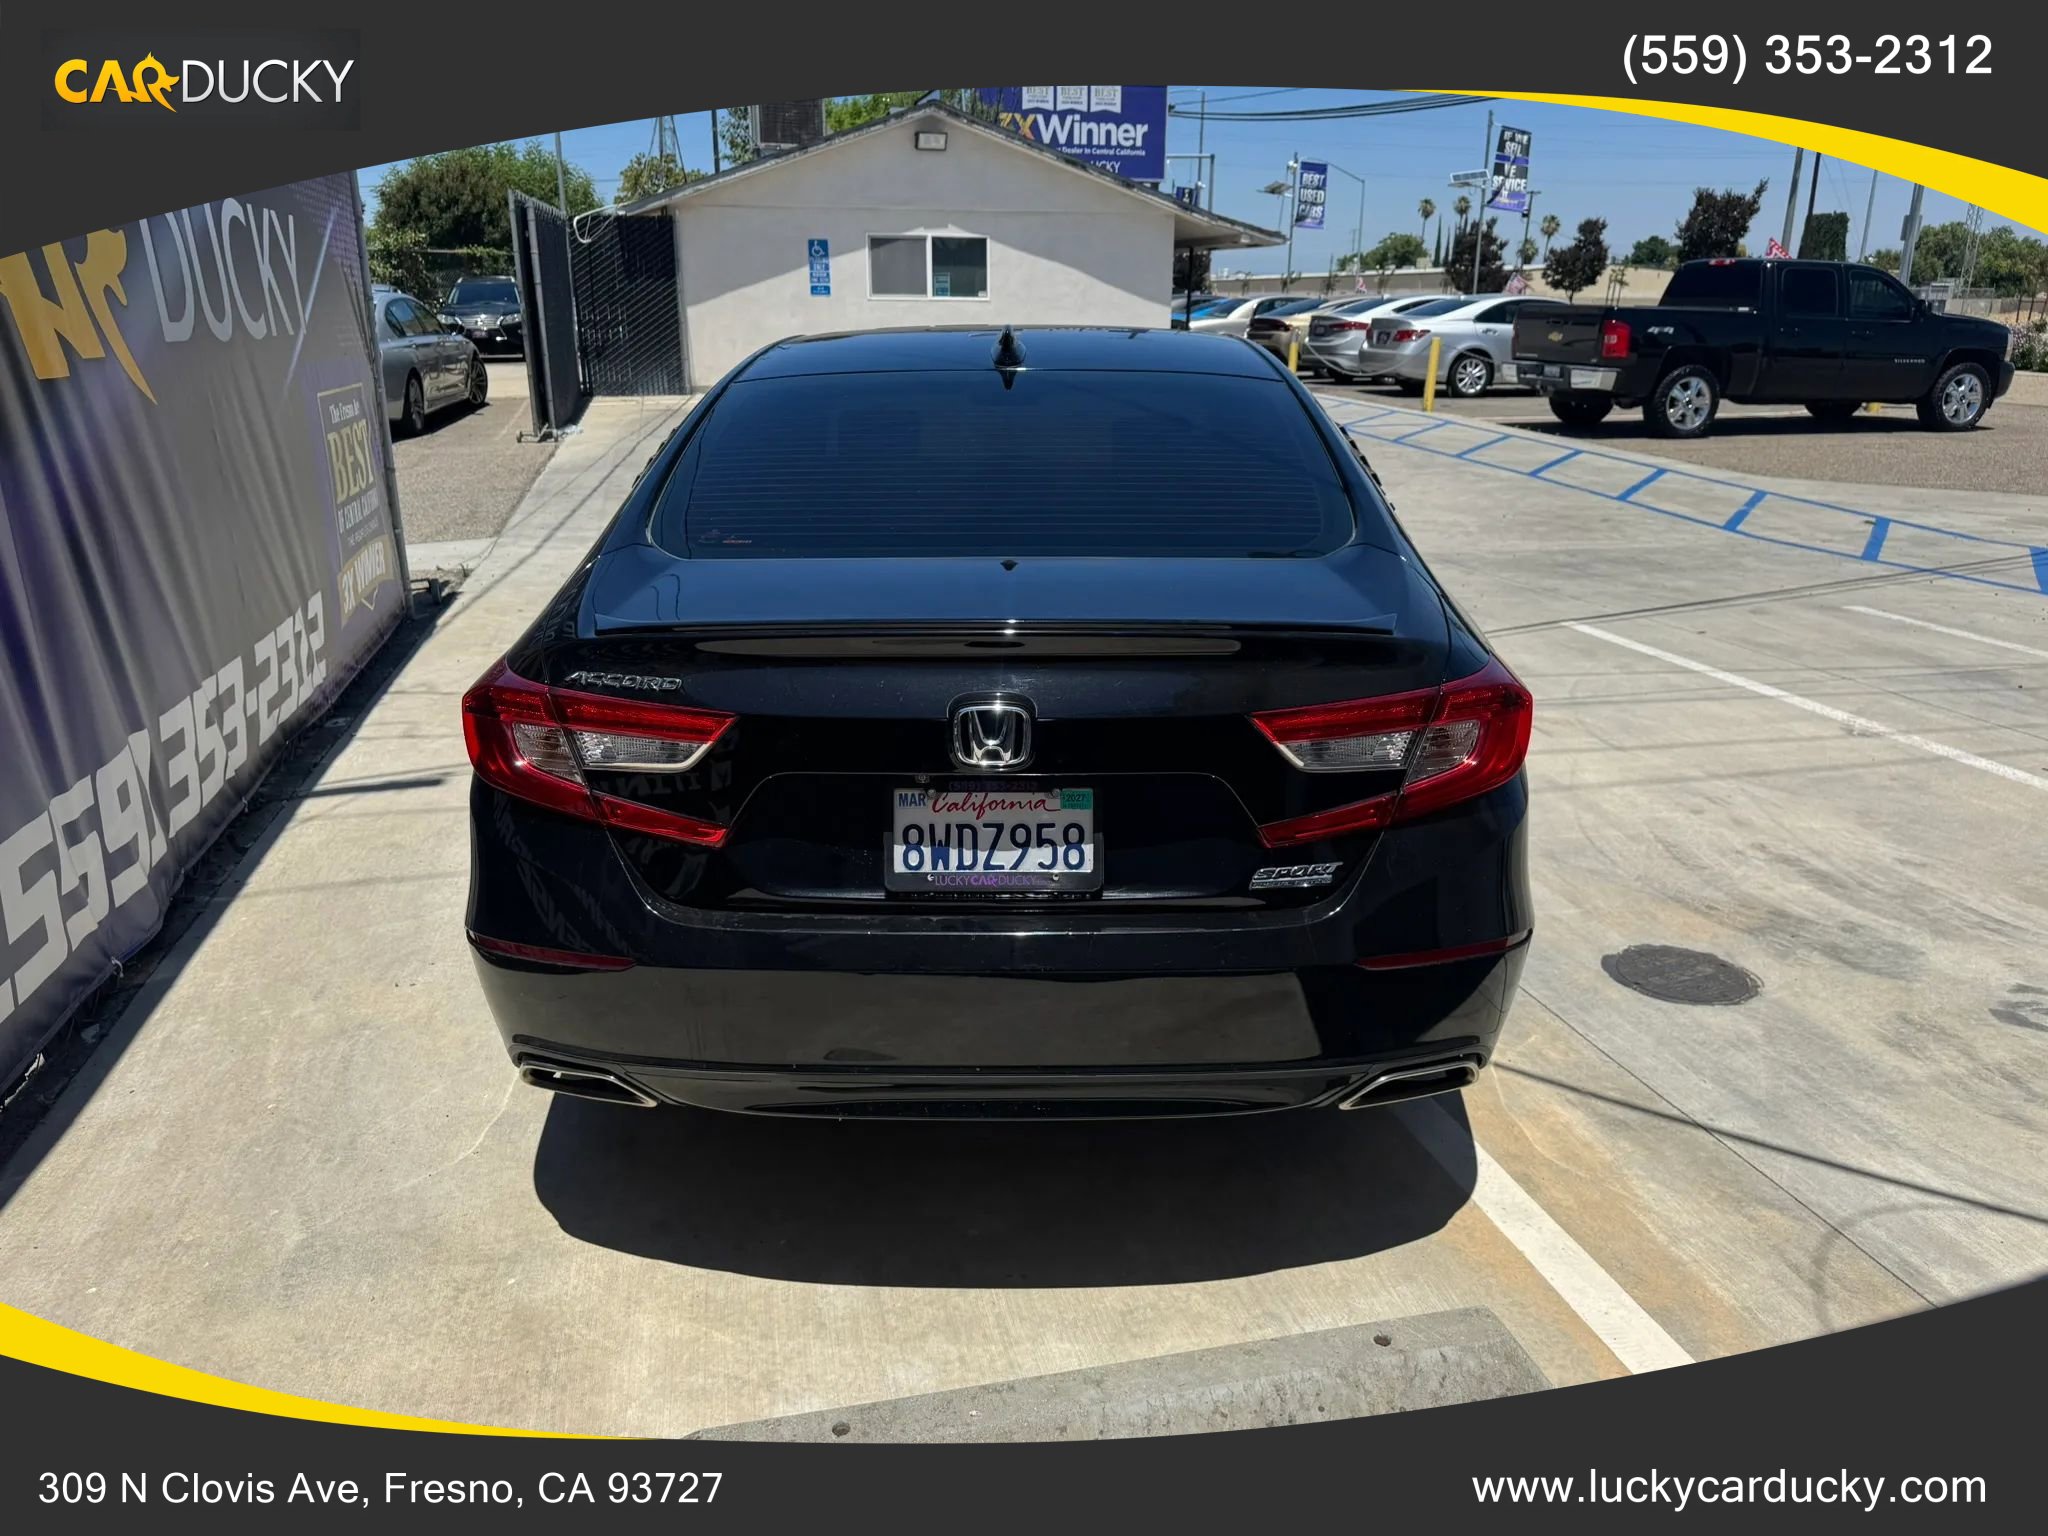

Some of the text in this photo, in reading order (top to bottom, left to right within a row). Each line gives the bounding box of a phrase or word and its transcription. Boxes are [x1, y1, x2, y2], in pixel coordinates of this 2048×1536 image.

[1037, 113, 1149, 147] Winner
[1302, 173, 1325, 188] BEST
[1492, 175, 1527, 192] SEVICE
[1300, 188, 1325, 204] USED
[327, 418, 375, 505] BEST
[342, 568, 356, 614] 3X
[354, 541, 386, 595] WINNER
[564, 670, 683, 692] ACCORD
[159, 590, 328, 838] 353-2312
[898, 792, 927, 807] MAR
[932, 791, 1062, 821] California
[901, 822, 1086, 872] 8WDZ958
[1251, 861, 1344, 880] SPORT
